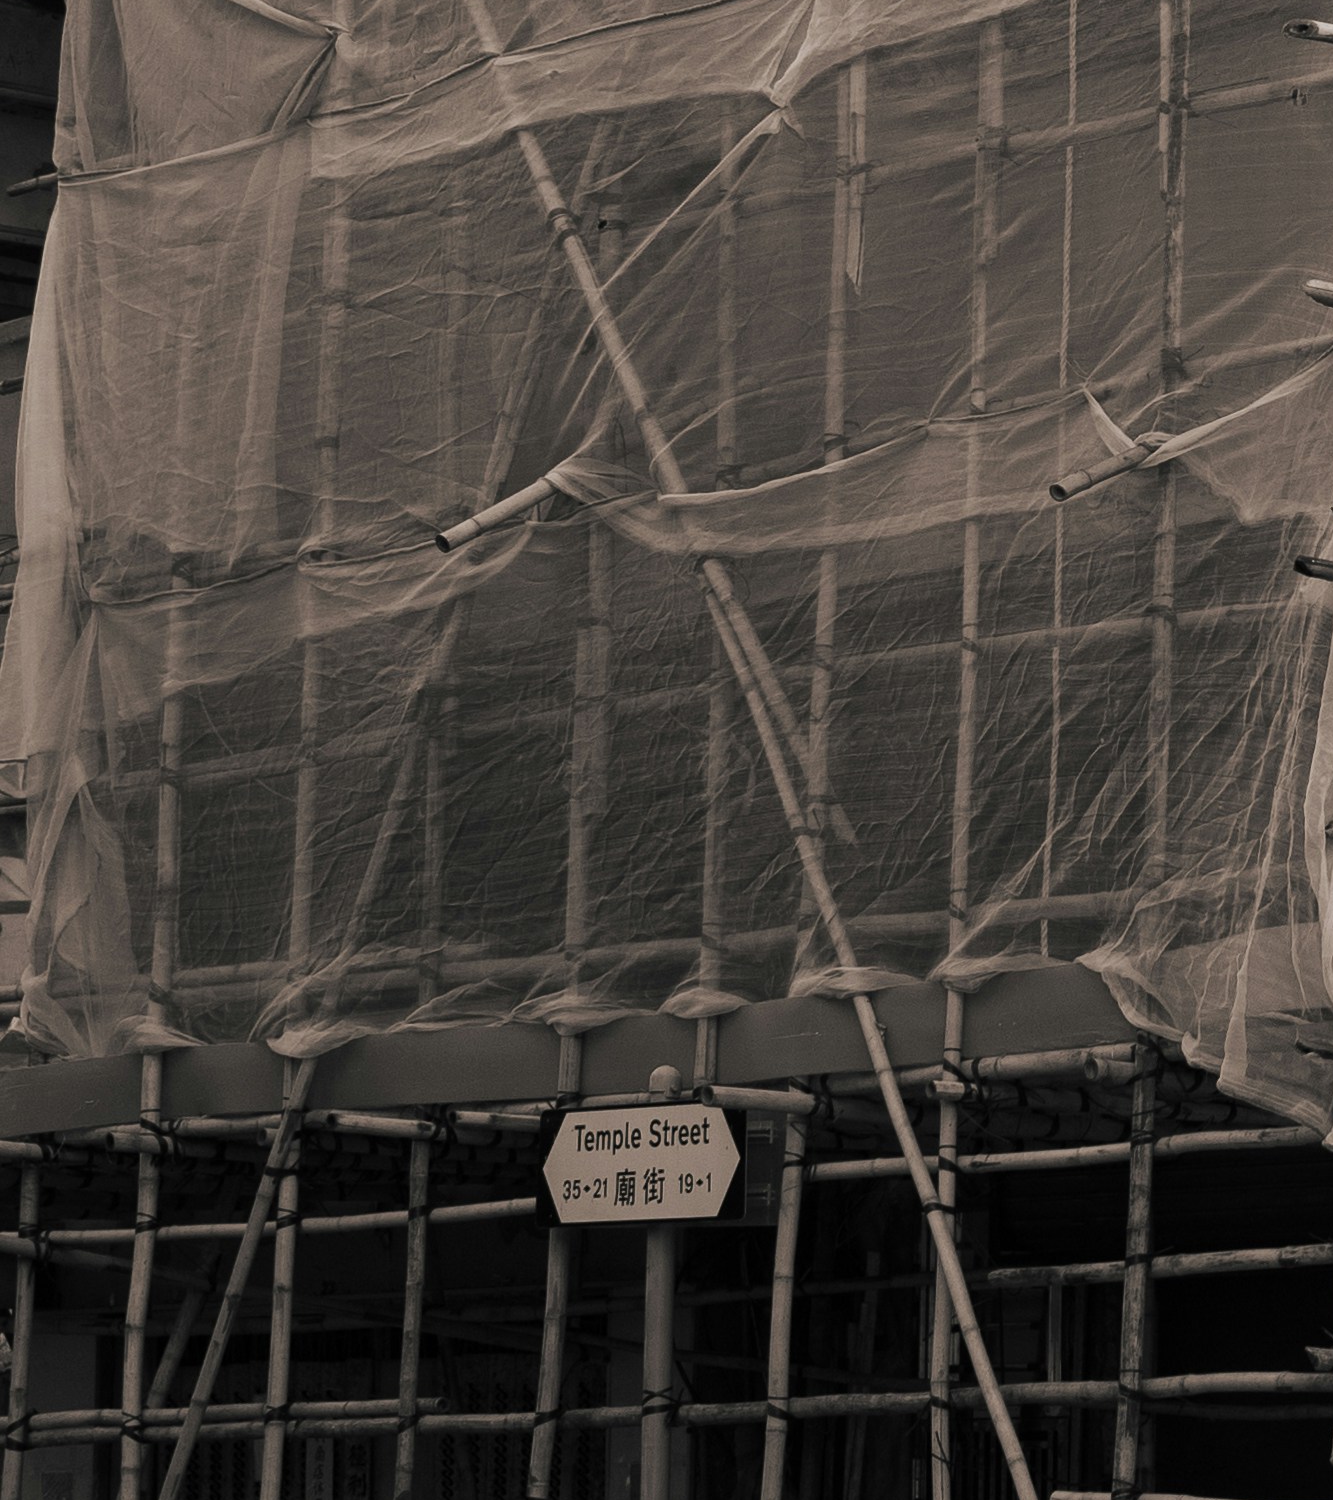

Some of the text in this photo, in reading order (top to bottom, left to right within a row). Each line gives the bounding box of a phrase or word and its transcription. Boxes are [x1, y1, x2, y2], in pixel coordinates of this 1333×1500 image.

[574, 1117, 710, 1155] Temple Street
[614, 1167, 665, 1206] 廟街
